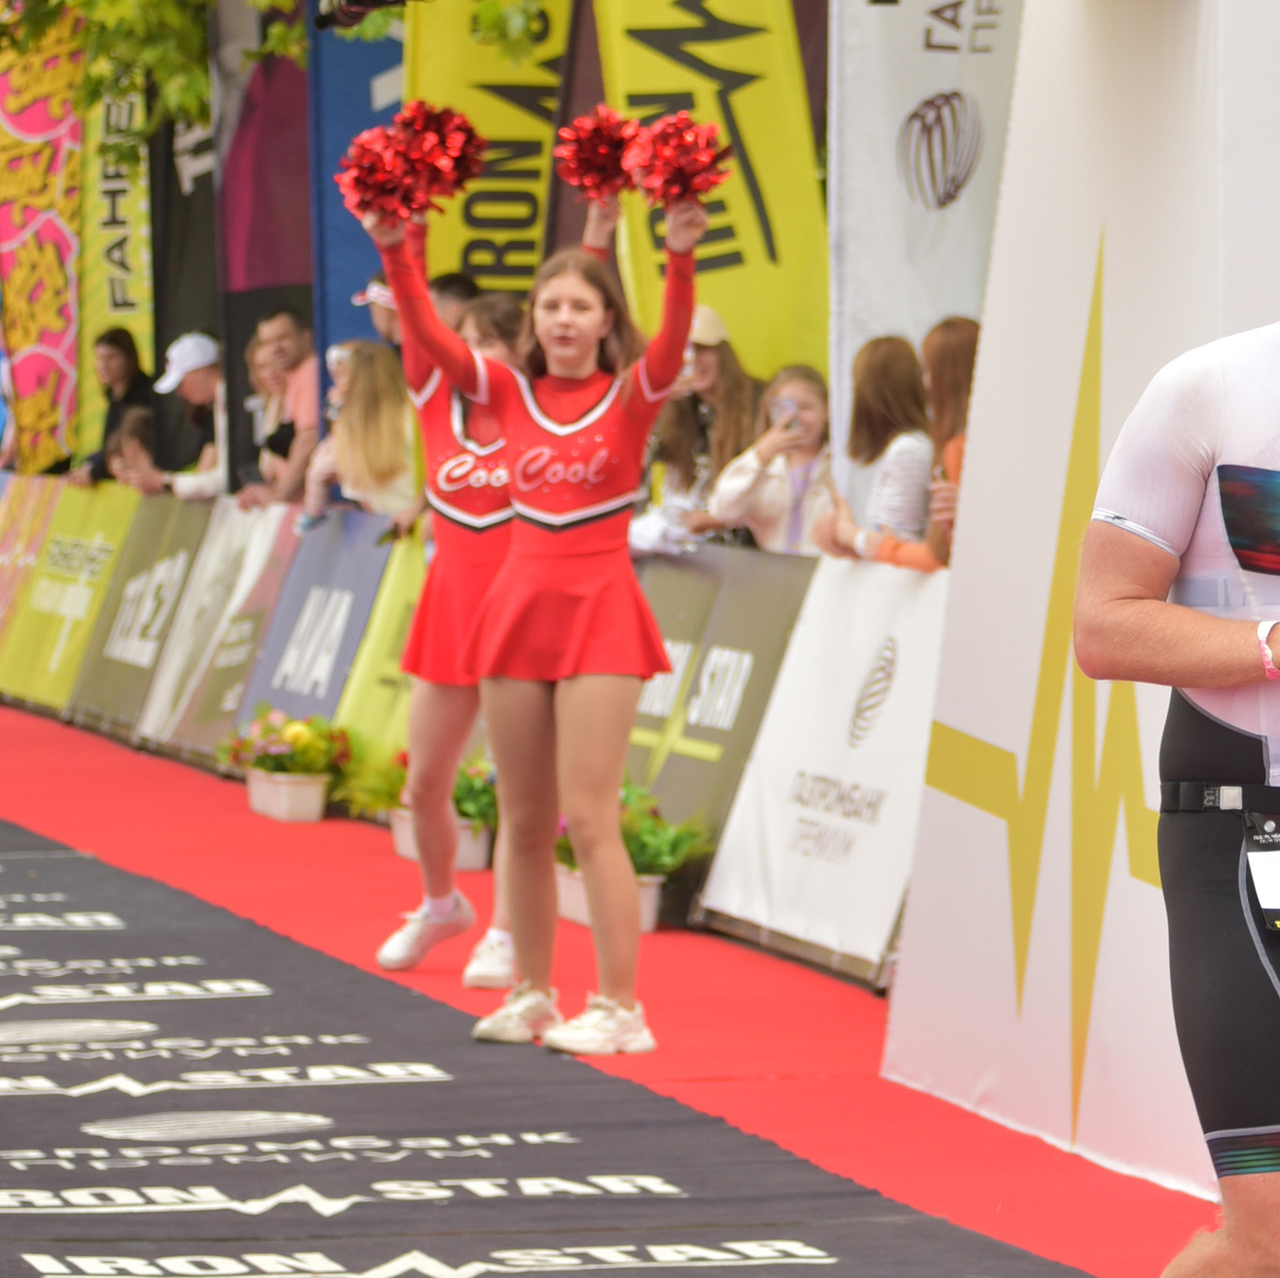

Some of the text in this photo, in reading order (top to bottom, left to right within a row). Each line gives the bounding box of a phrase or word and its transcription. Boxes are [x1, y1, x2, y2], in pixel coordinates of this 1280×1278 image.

[514, 445, 609, 492] Cool
[370, 1175, 690, 1199] STAR
[20, 1240, 830, 1276] IRON STAR
